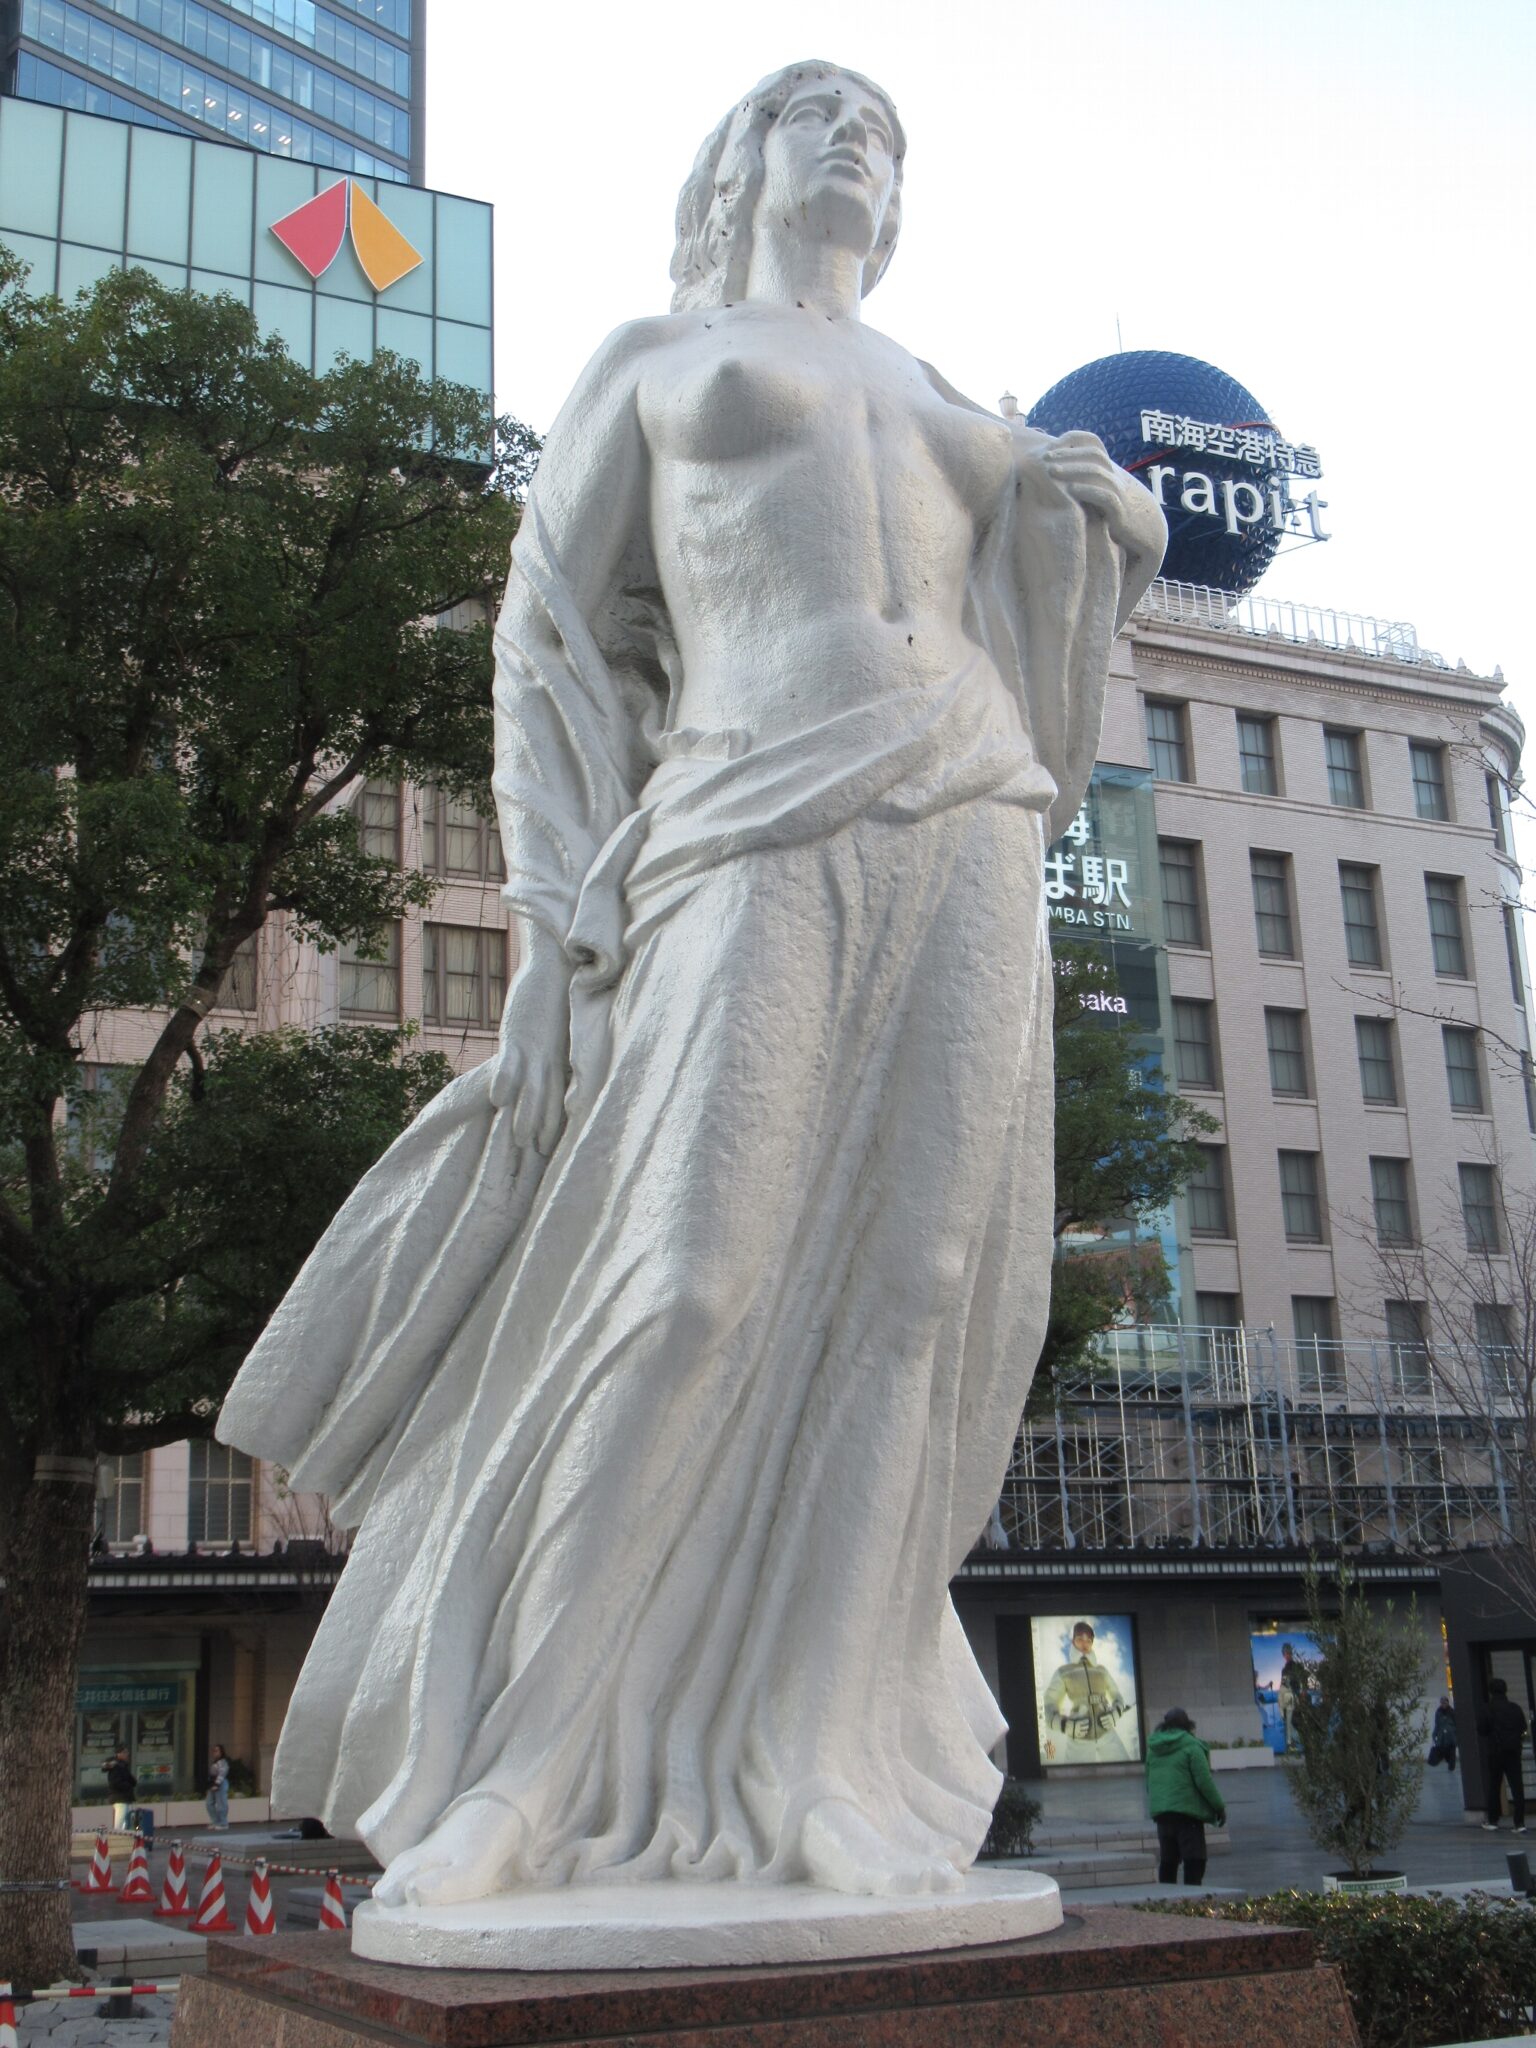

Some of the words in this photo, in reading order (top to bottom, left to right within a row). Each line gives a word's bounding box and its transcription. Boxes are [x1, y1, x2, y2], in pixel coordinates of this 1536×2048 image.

[1140, 409, 1324, 479] 南海空港特急
[1067, 989, 1128, 1014] saka
